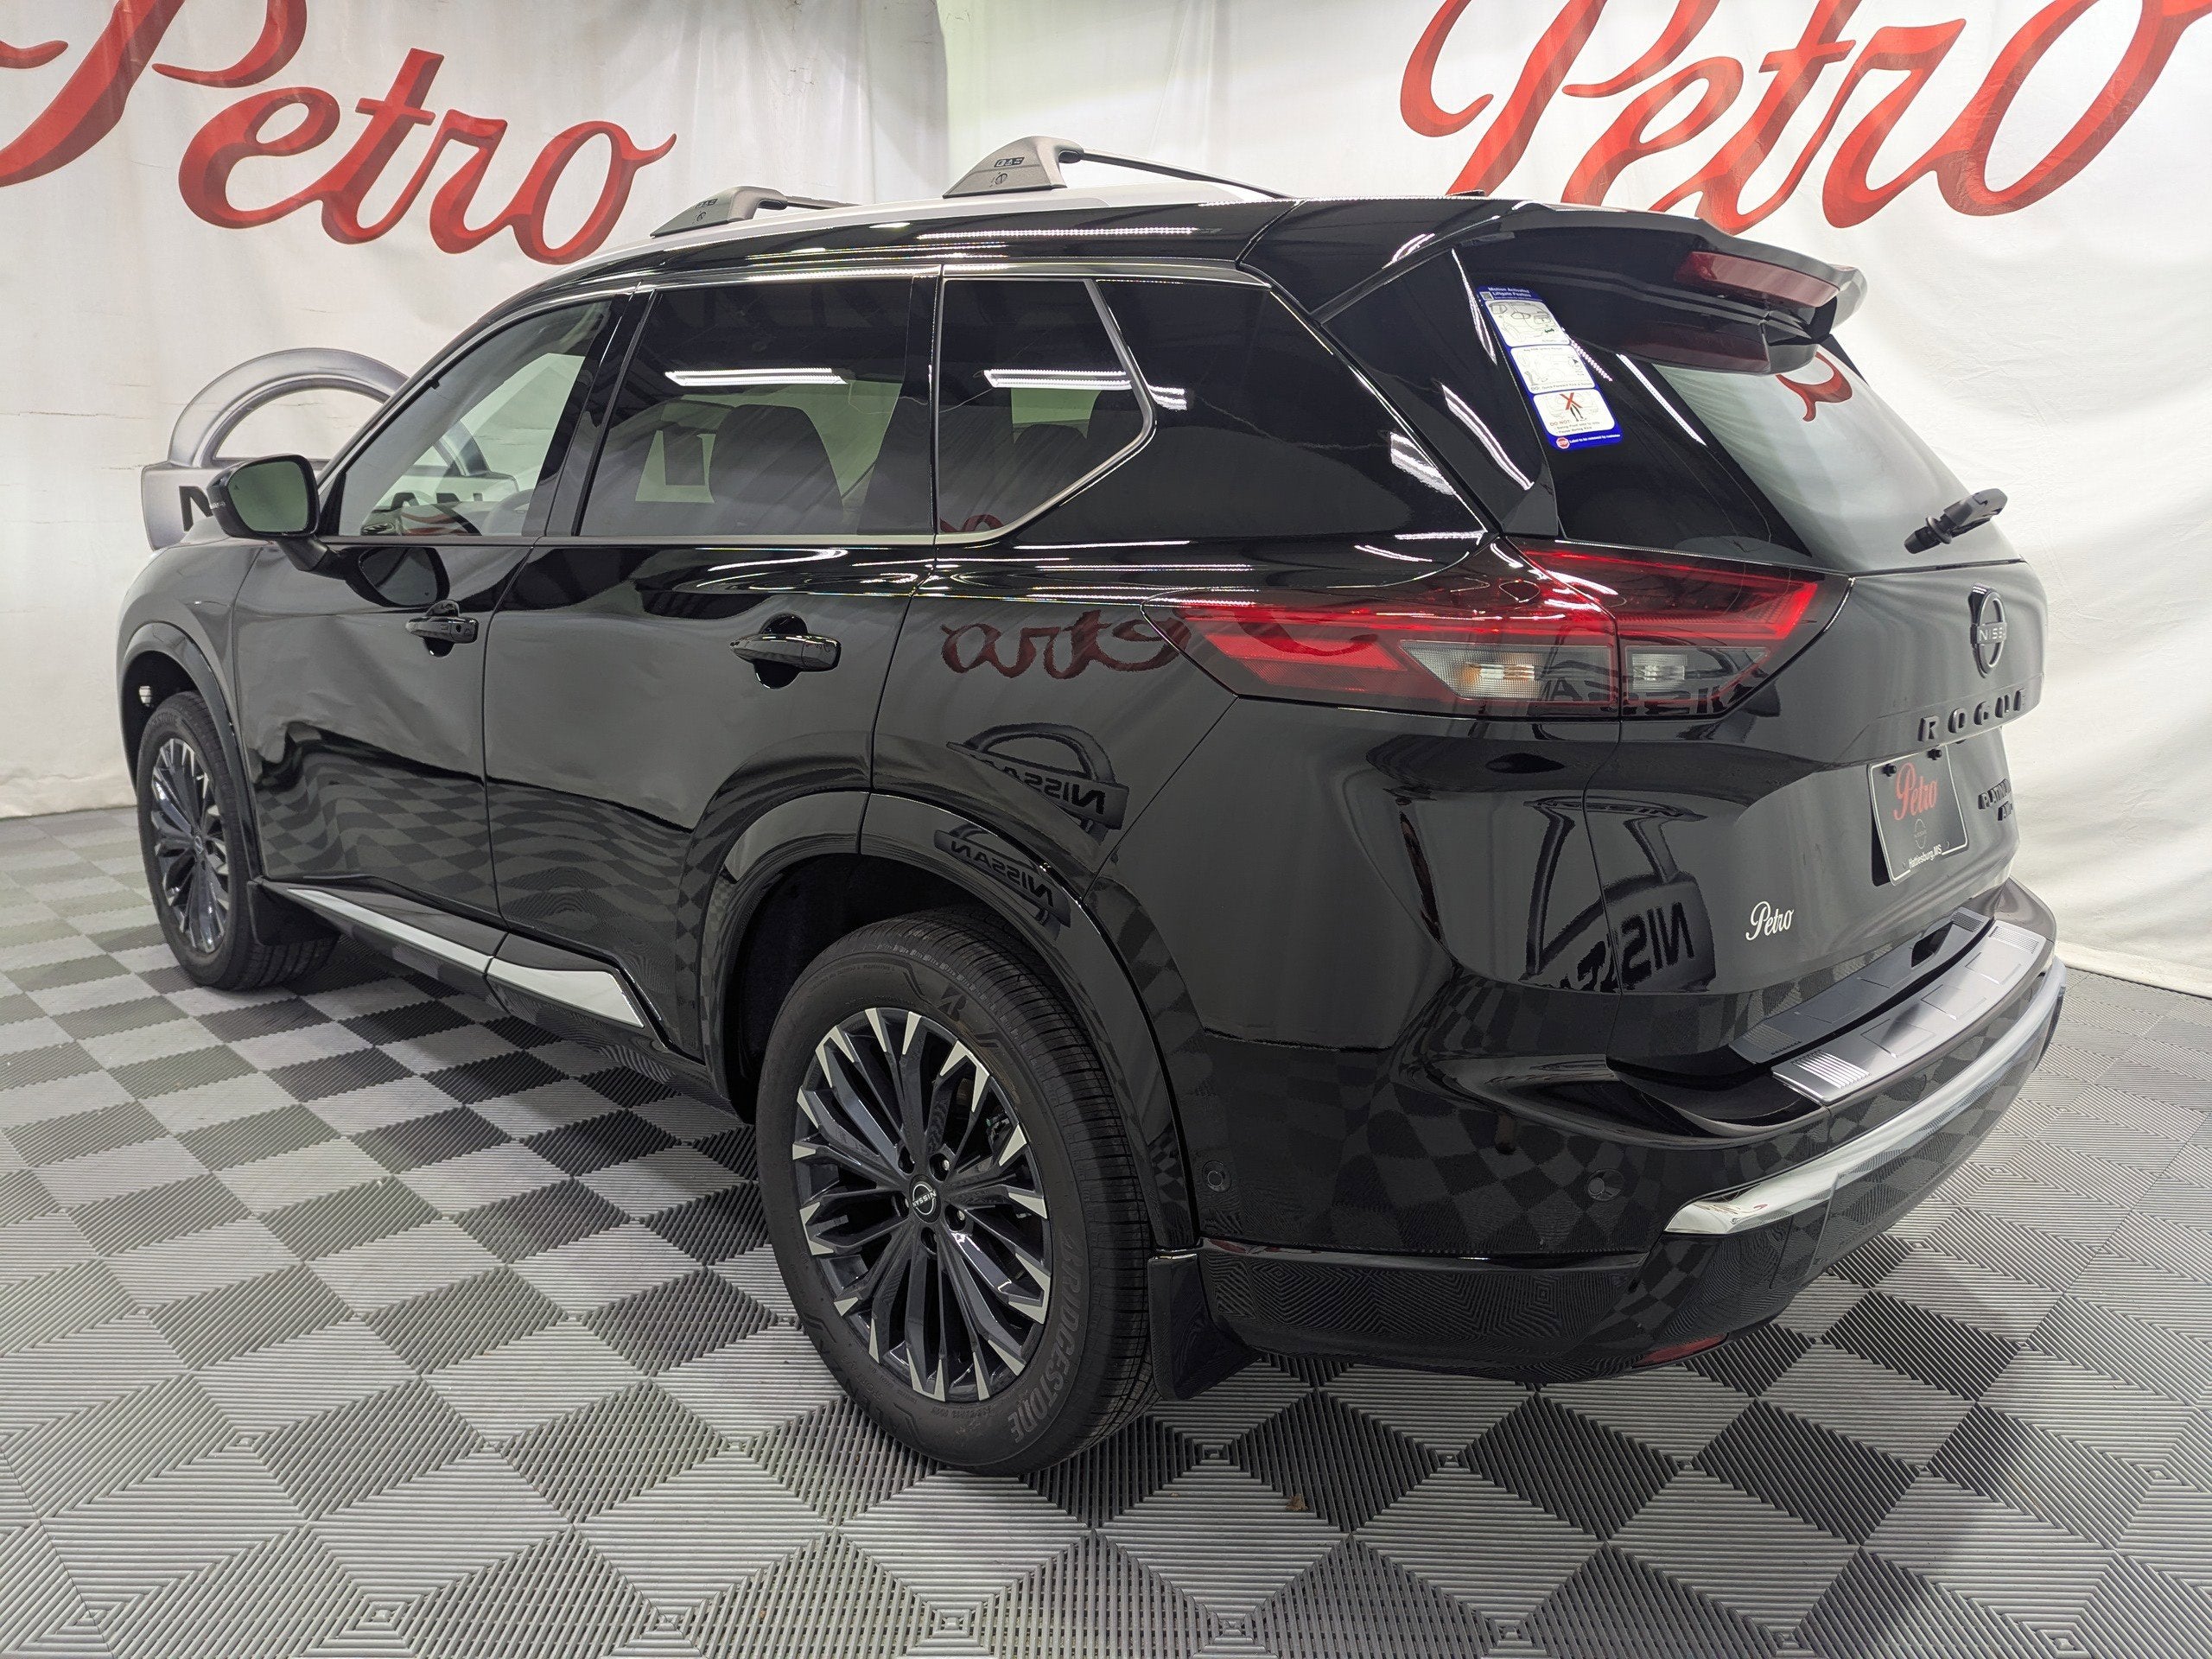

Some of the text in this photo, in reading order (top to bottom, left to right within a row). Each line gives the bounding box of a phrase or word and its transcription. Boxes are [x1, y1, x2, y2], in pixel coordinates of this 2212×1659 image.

[0, 0, 677, 265] Petro
[1400, 0, 2212, 235] Petro
[1979, 626, 2006, 643] NISS
[1917, 688, 2026, 742] ROGUE
[1892, 761, 1938, 821] Petro
[1745, 900, 1795, 941] Petro
[912, 1189, 938, 1208] NISSAN
[1007, 1233, 1084, 1444] BRIDGESTONE
